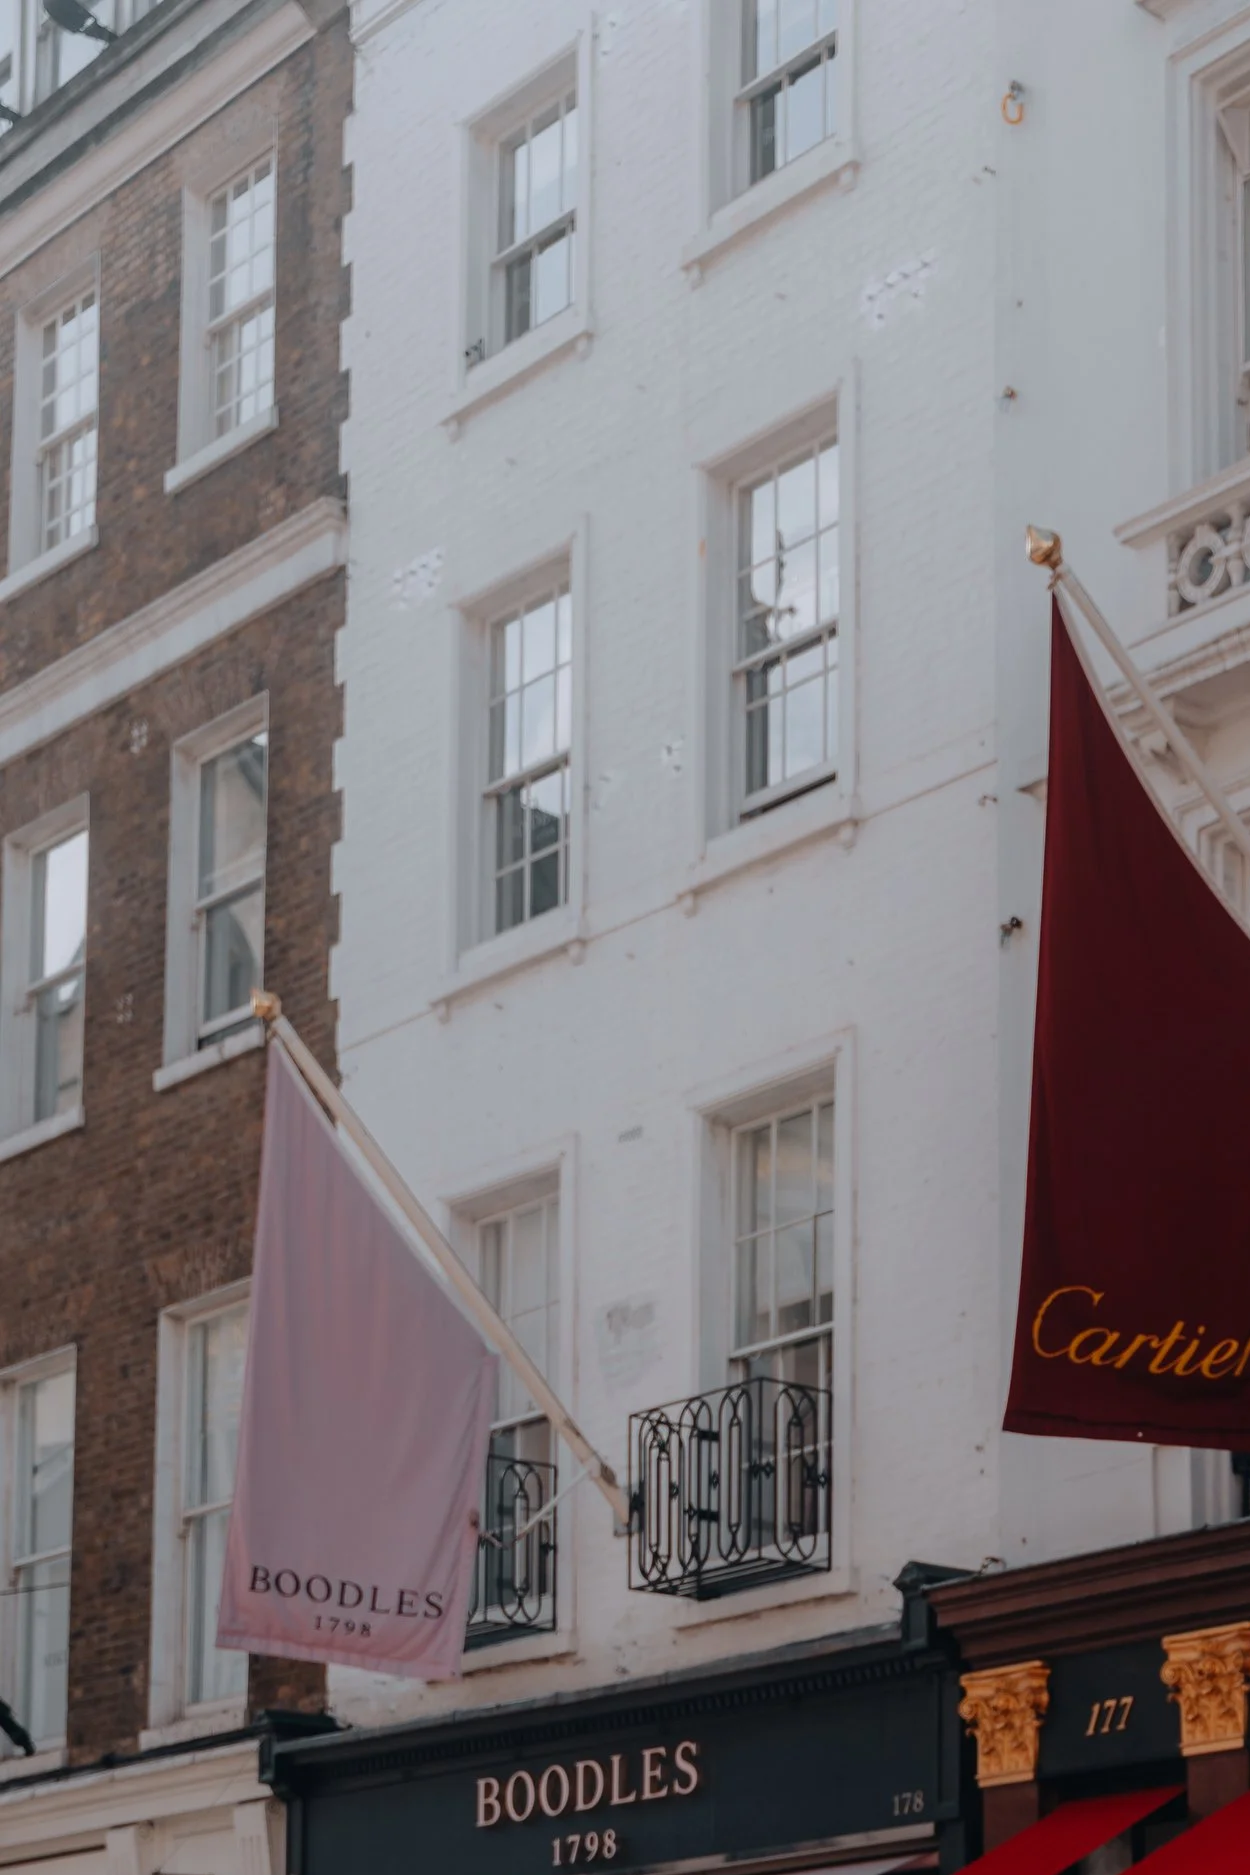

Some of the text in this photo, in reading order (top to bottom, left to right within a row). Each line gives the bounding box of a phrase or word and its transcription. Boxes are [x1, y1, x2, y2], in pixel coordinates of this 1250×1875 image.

[248, 1564, 445, 1620] BOODLES
[313, 1615, 373, 1639] 1798
[1084, 1695, 1135, 1737] 177
[475, 1740, 700, 1828] BOODLES
[892, 1791, 925, 1817] 178
[551, 1830, 618, 1867] 1798
